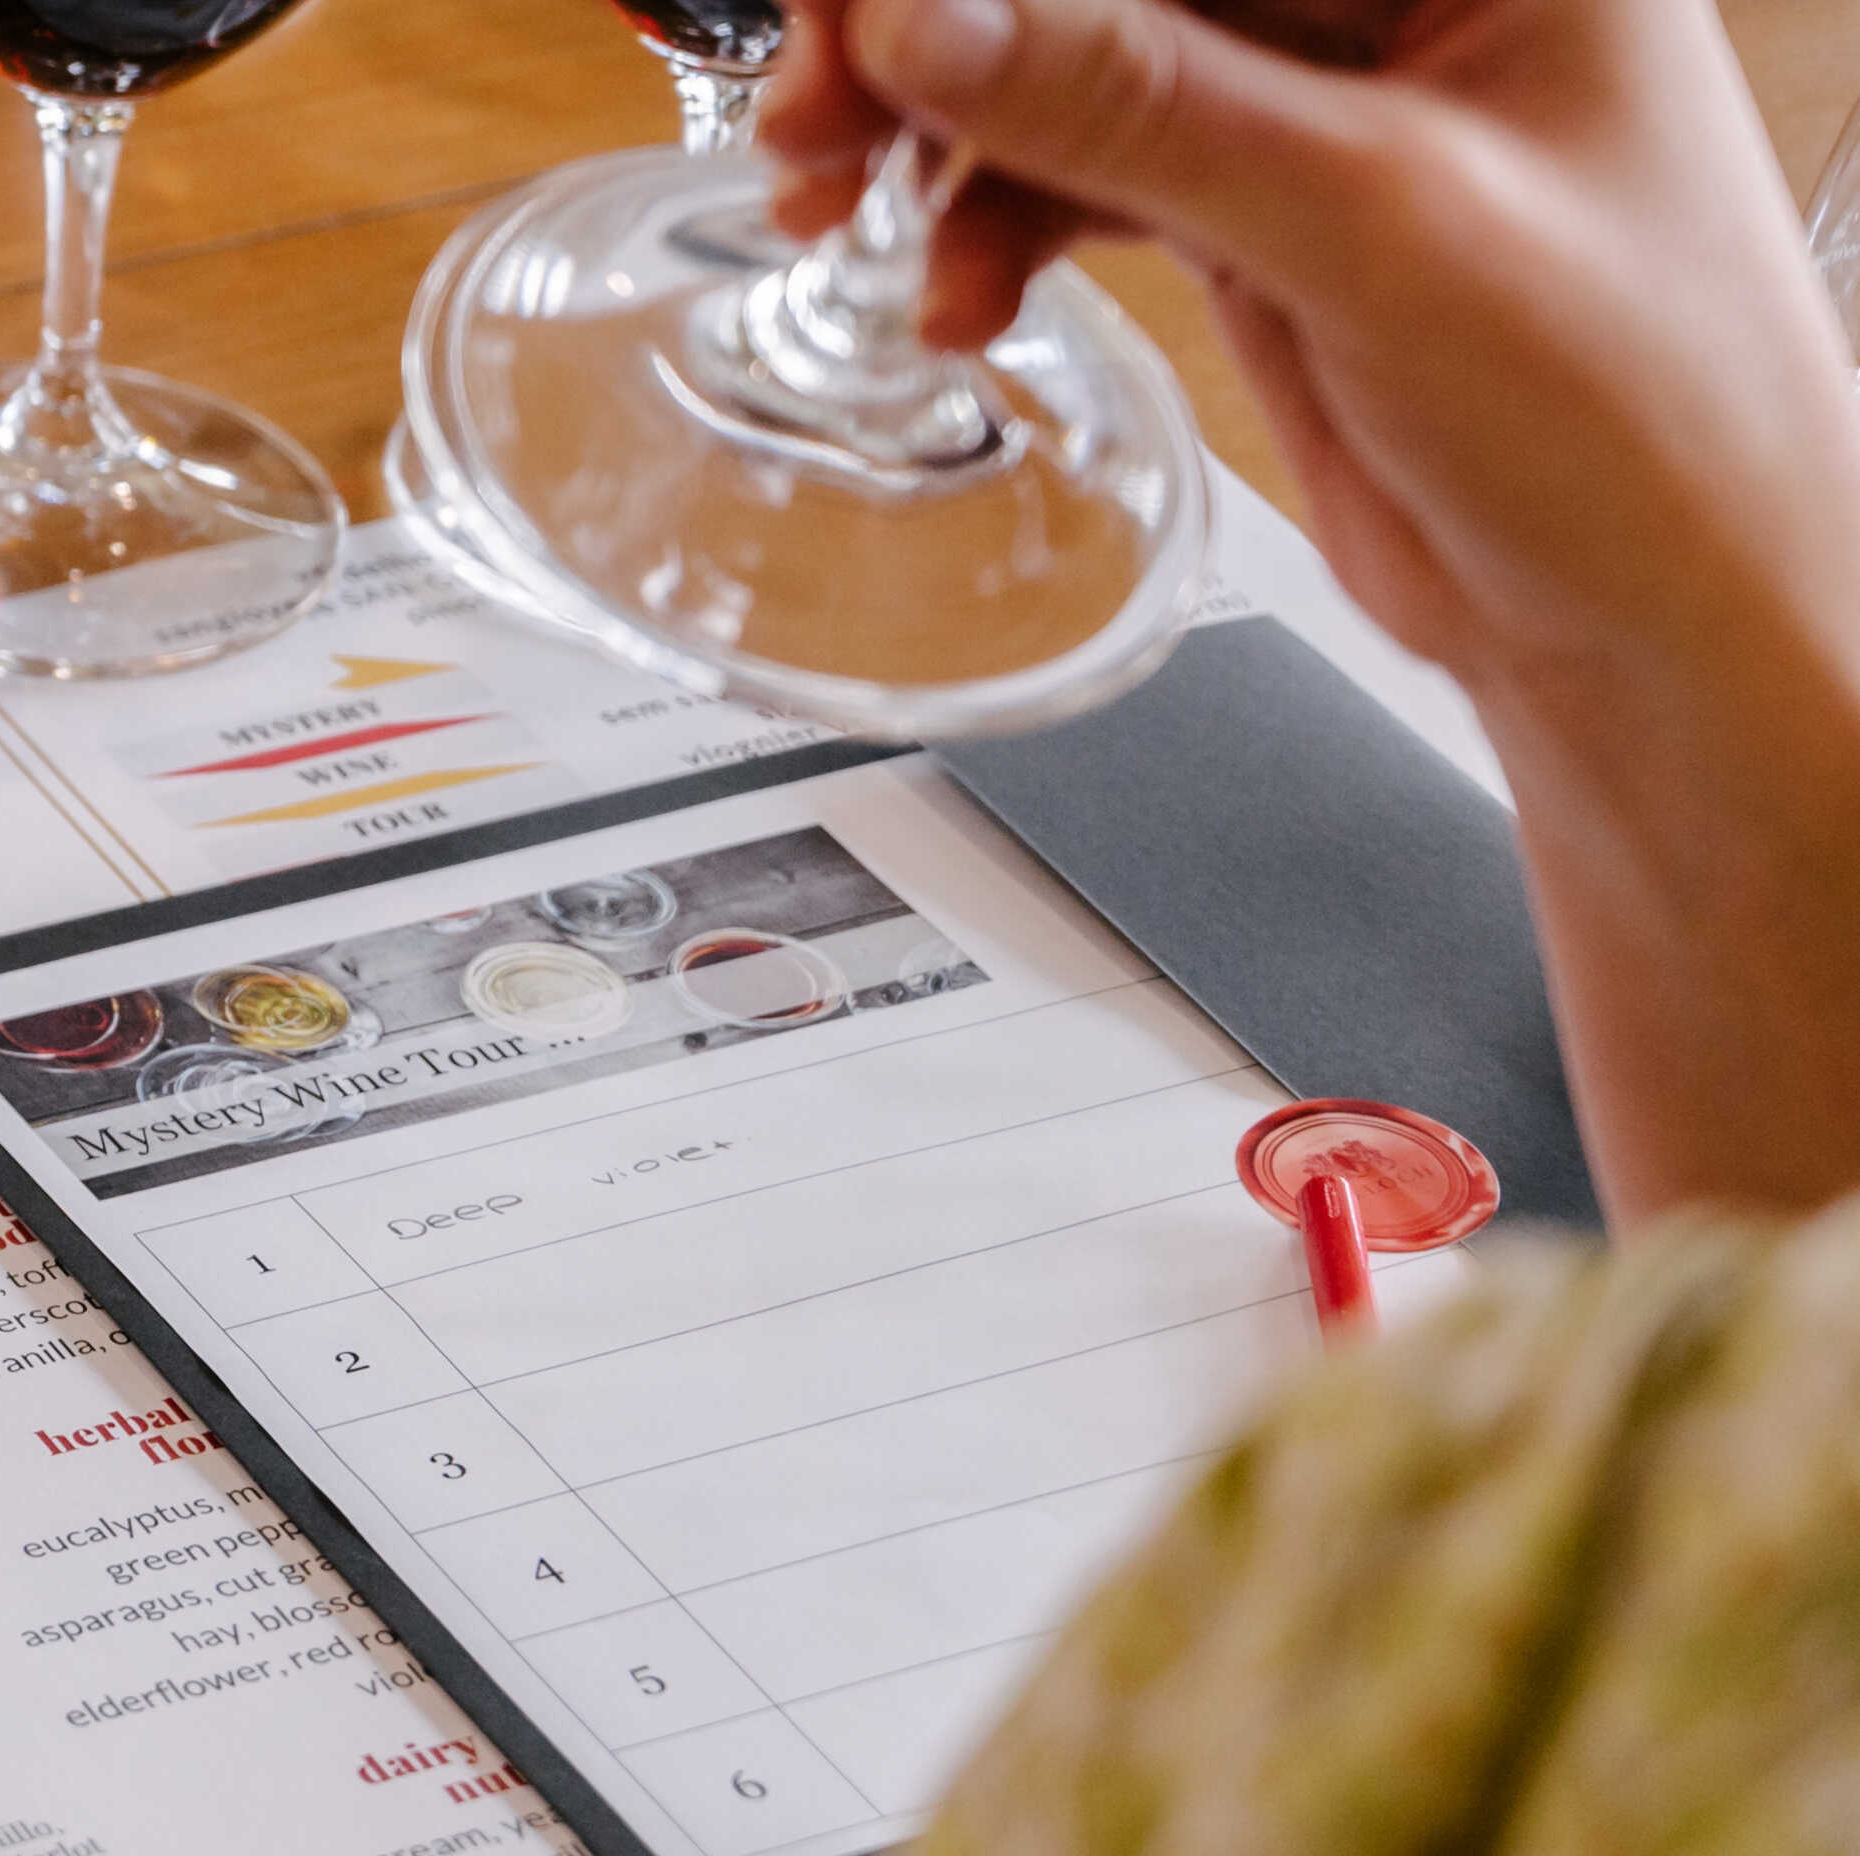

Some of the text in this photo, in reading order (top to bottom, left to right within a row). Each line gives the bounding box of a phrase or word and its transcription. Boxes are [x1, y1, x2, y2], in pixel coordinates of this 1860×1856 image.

[219, 697, 382, 749] MYSTERY
[296, 751, 400, 788] WINE
[342, 801, 452, 840] TOUR
[69, 1092, 268, 1161] Mystery
[265, 1064, 409, 1110] Wine
[402, 1034, 529, 1078] Tour
[6, 1256, 72, 1291] toff
[244, 1253, 277, 1275] 1
[334, 1349, 371, 1374] 2
[34, 1396, 196, 1457] herbal
[138, 1429, 227, 1467] flor
[429, 1451, 469, 1481] 3
[22, 1496, 227, 1560] eucalyptus,
[106, 1516, 303, 1587] green pepp
[533, 1556, 567, 1586] 4
[21, 1552, 337, 1649] asparagus, cut gra
[170, 1590, 369, 1655] hay, blosso
[65, 1658, 290, 1730] elderflower,
[288, 1634, 355, 1671] red
[629, 1664, 669, 1698] 5
[357, 1735, 479, 1785] dairy
[442, 1761, 530, 1804] nut
[730, 1768, 770, 1801] 6
